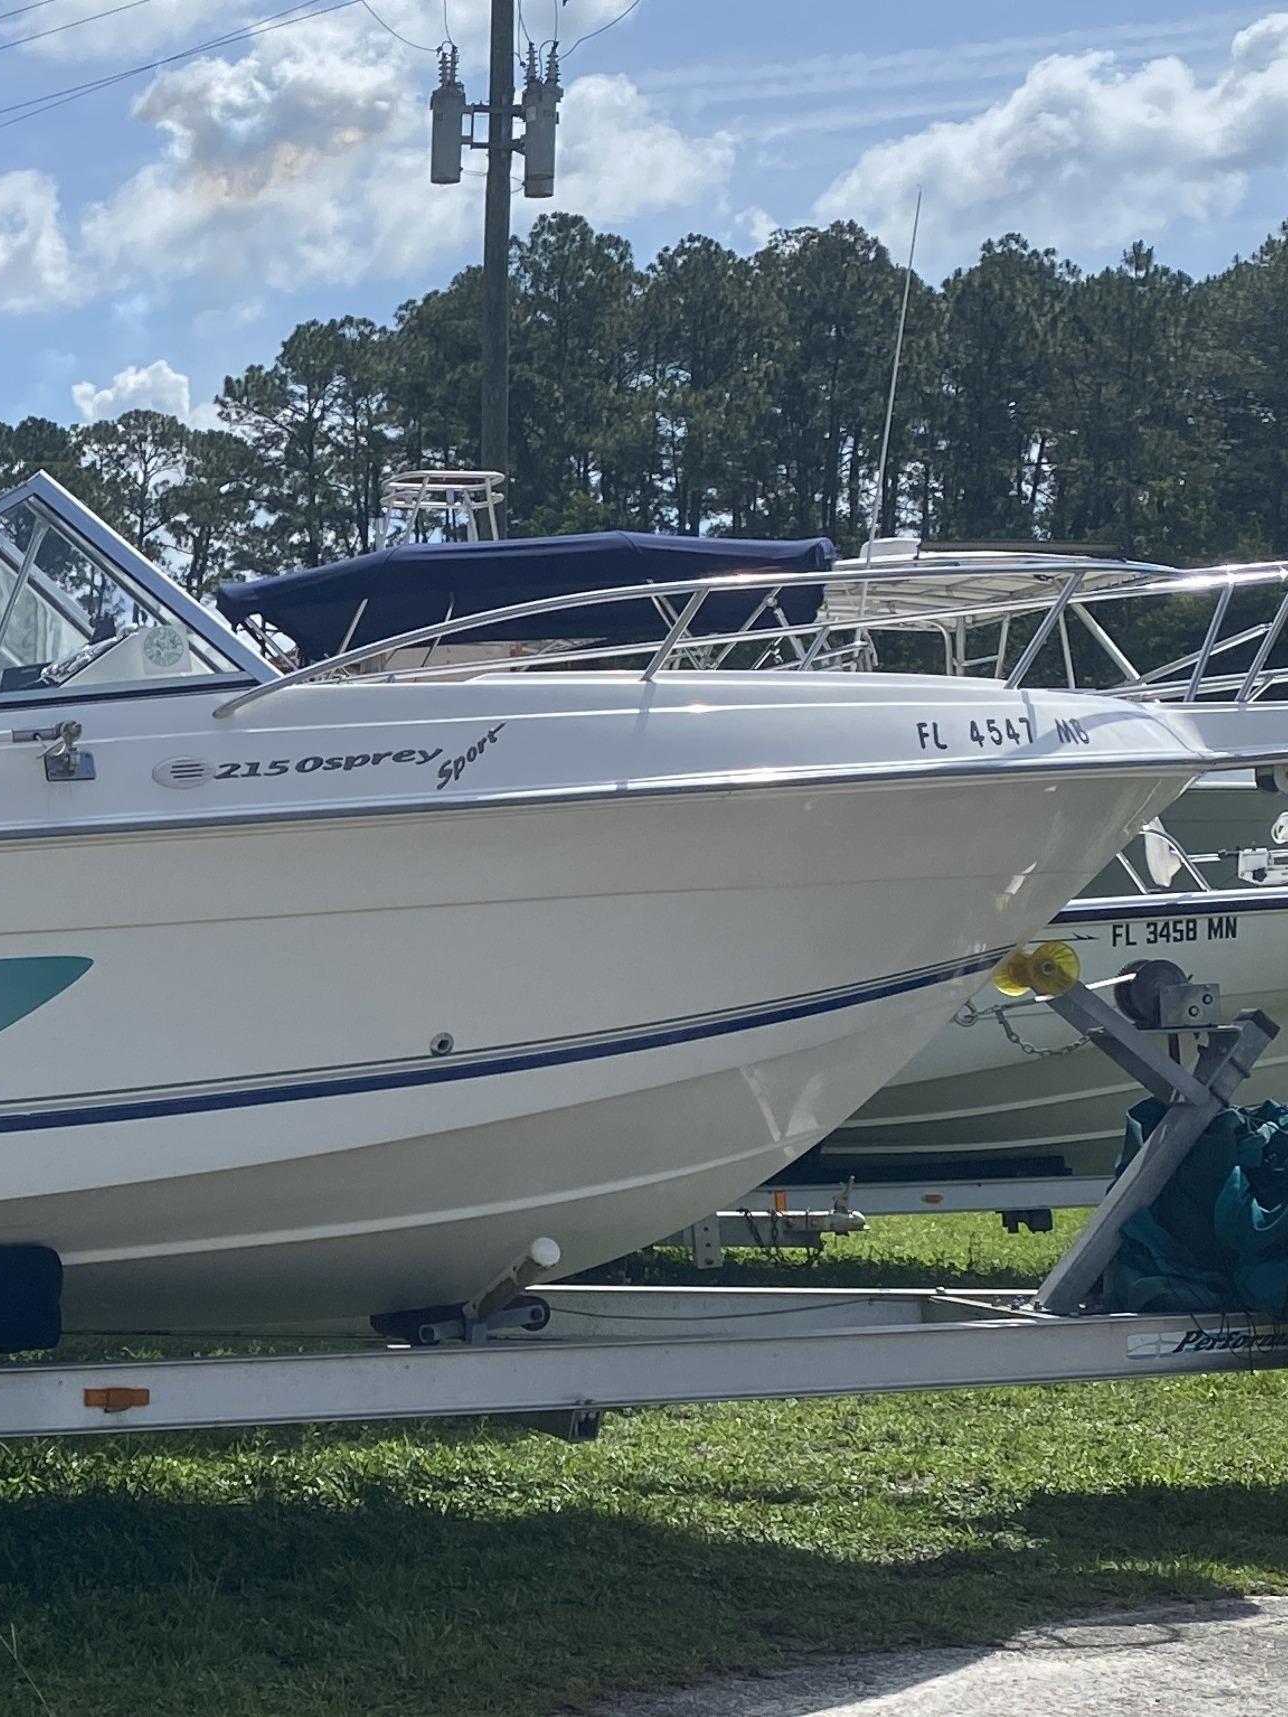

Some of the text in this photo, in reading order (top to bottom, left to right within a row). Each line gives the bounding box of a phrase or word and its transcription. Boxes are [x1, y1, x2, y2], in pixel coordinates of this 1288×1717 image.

[916, 721, 948, 750] FL
[969, 717, 1034, 748] 4547
[214, 748, 443, 780] 215 Osprey
[1112, 916, 1237, 947] FL 3458 MN
